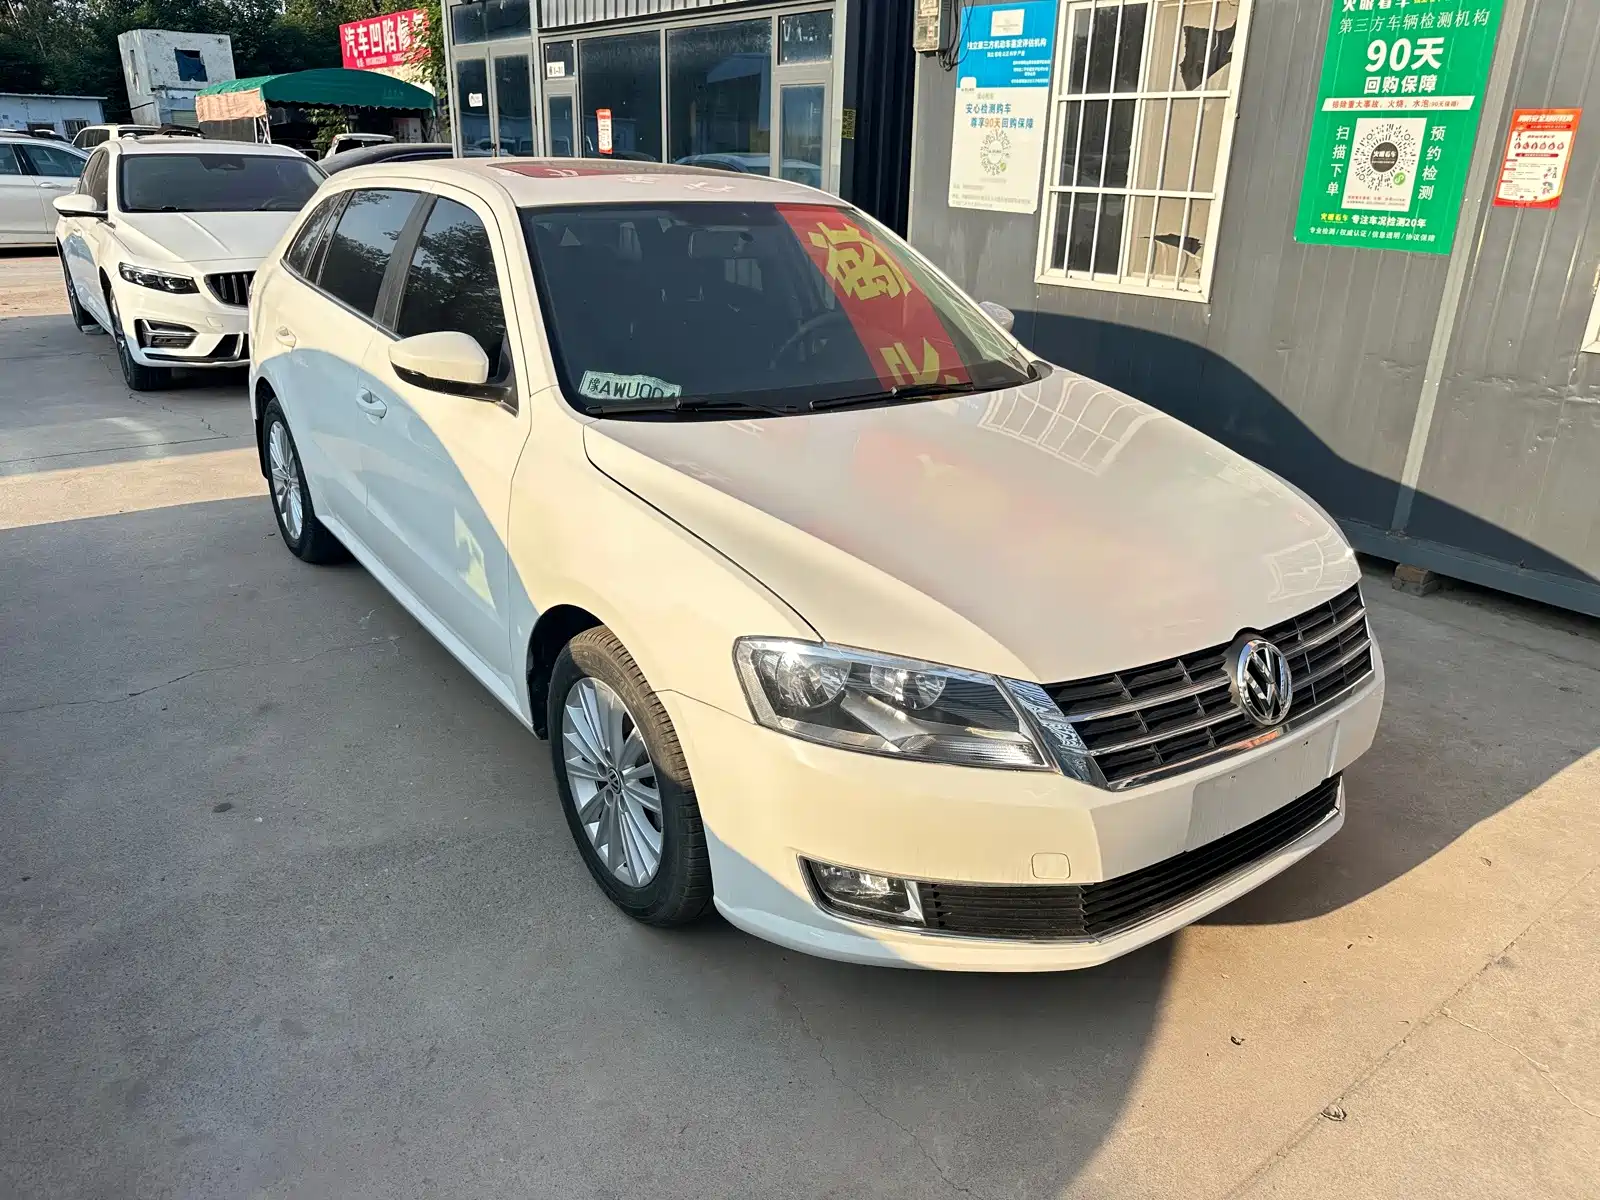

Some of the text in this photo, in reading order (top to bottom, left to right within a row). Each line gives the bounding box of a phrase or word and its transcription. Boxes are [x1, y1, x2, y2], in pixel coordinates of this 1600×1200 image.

[1338, 8, 1490, 35] 第三方车辆检测机构
[1364, 37, 1445, 73] 90天
[1363, 74, 1438, 95] 回购保障
[965, 103, 1012, 115] 安心检测购车
[970, 117, 1034, 129] 尊享90天回购保障
[1326, 125, 1350, 196] 扫描下单
[1418, 125, 1447, 201] 预约检测
